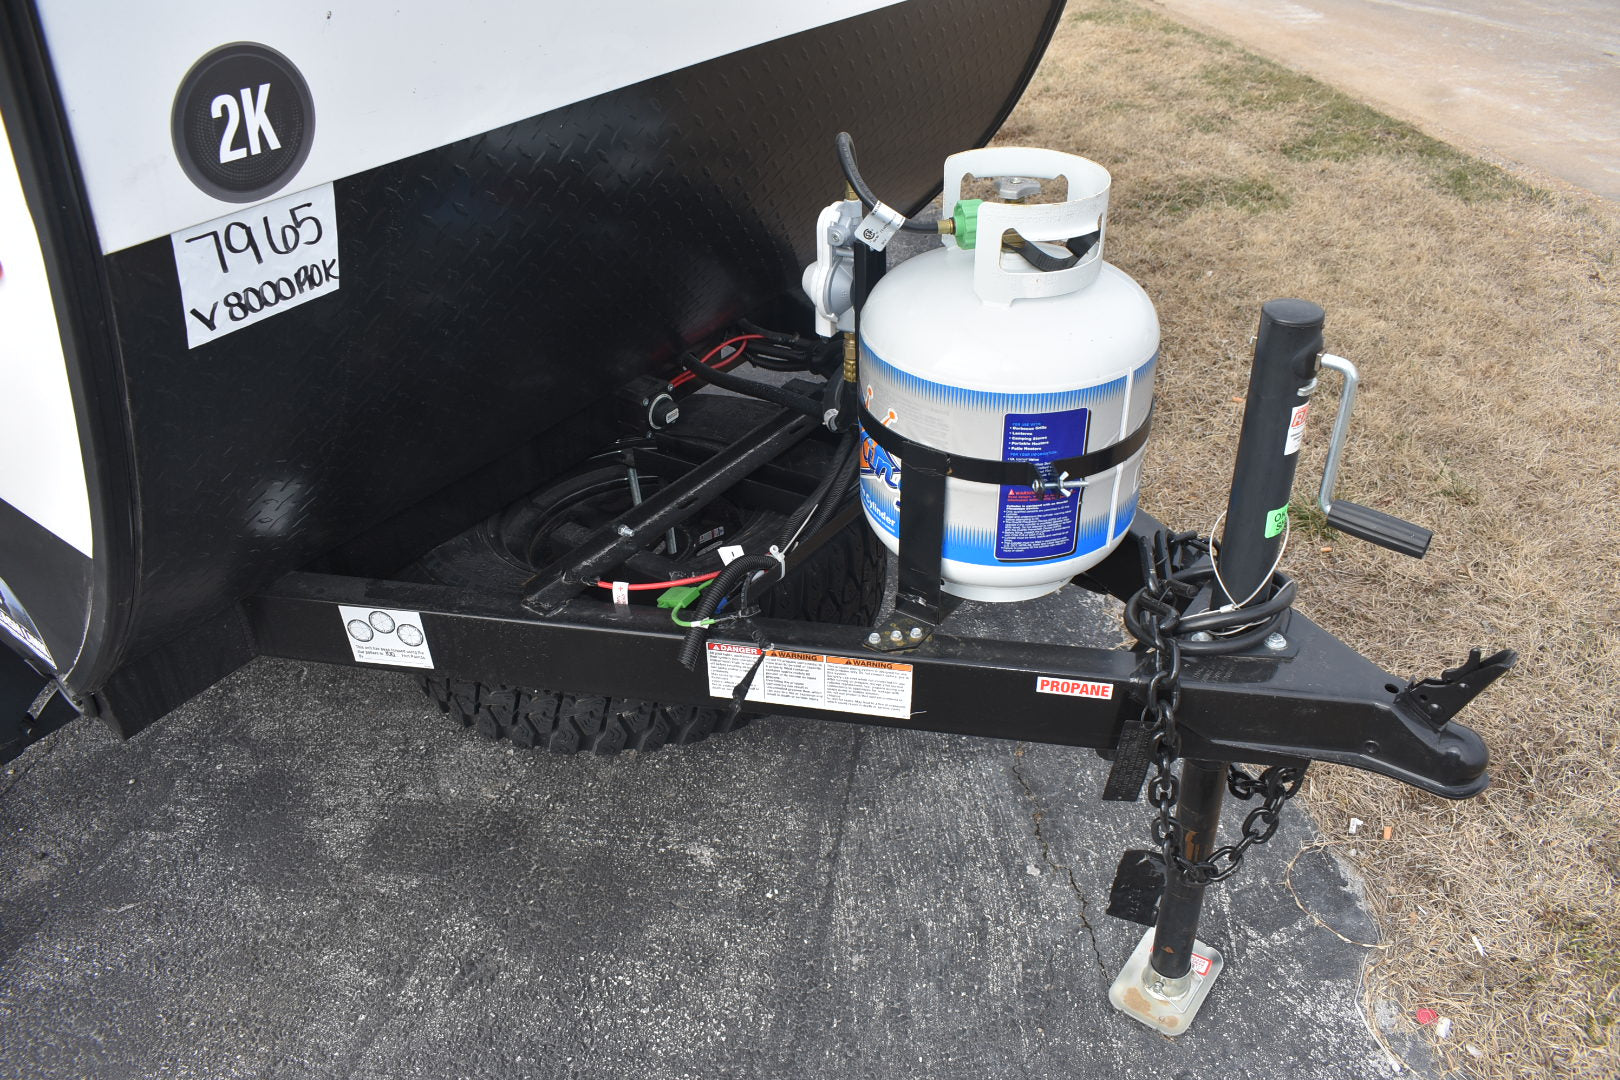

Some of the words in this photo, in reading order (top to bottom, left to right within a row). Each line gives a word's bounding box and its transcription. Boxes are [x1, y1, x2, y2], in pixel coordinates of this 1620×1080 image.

[210, 82, 282, 164] 2K
[185, 202, 323, 274] 7965
[720, 645, 758, 655] DANGER
[778, 651, 818, 661] WARNING
[853, 659, 893, 670] WARNING
[1040, 679, 1111, 697] PROPANE
